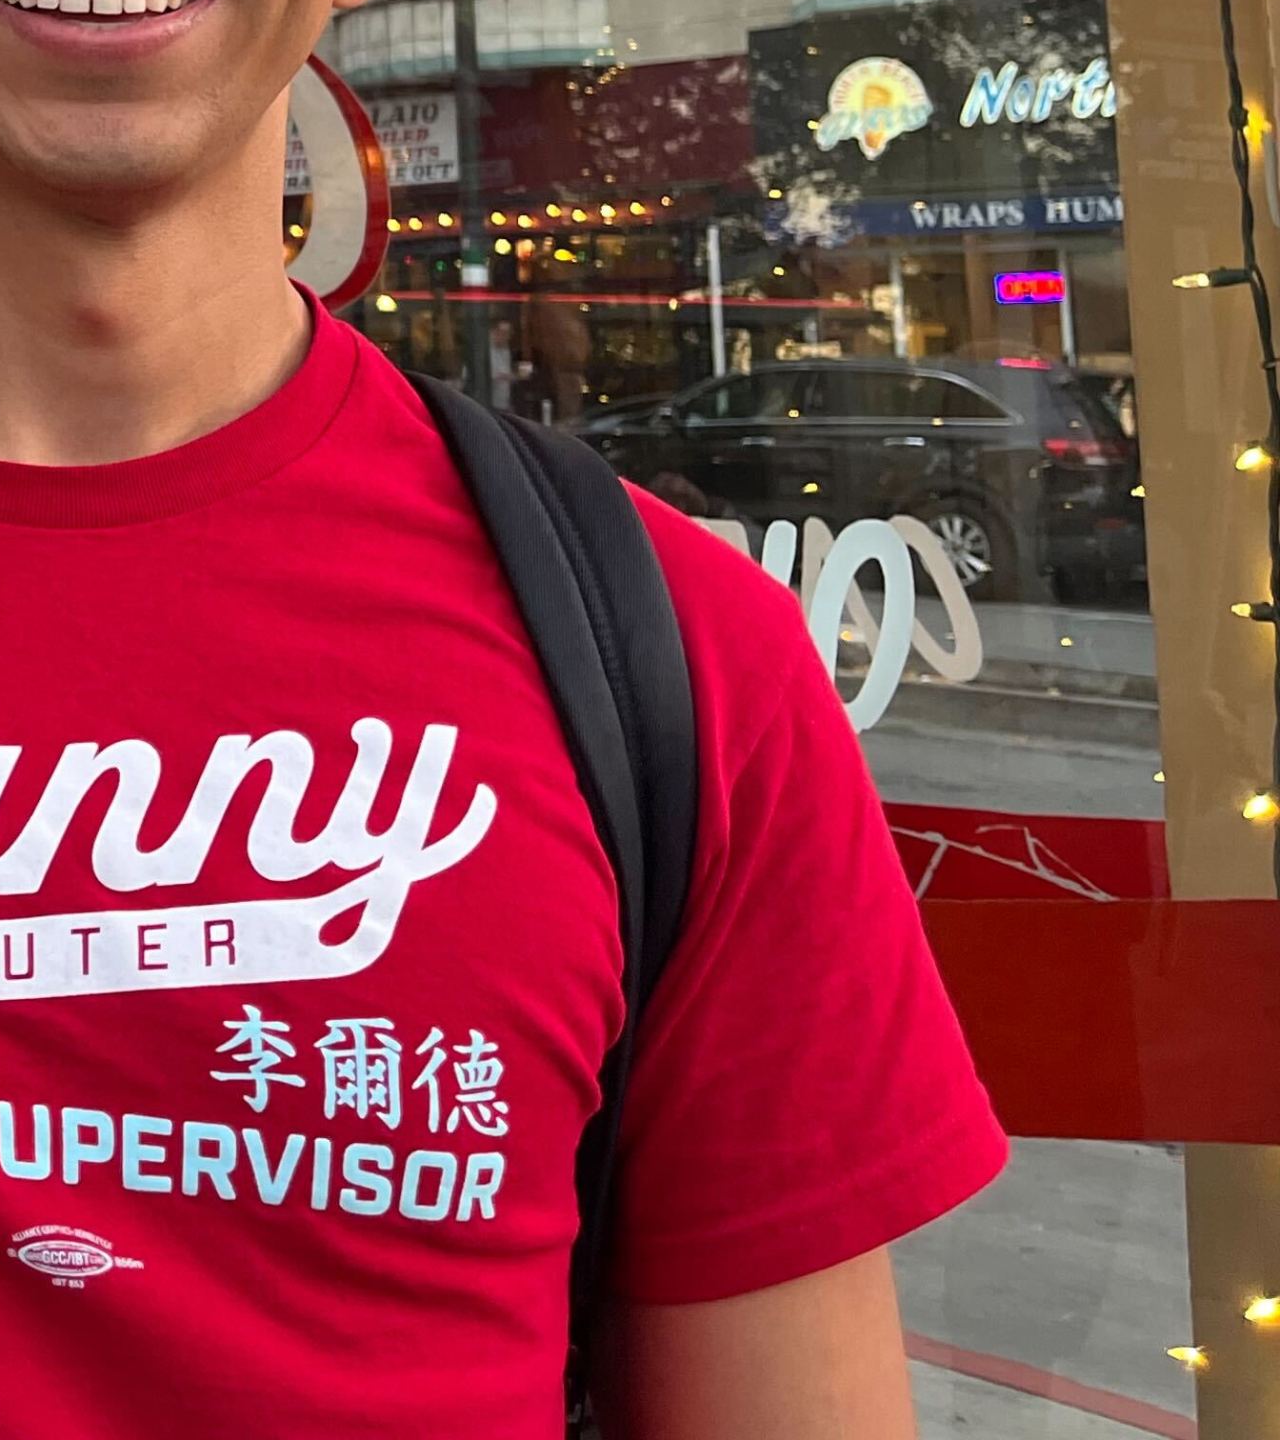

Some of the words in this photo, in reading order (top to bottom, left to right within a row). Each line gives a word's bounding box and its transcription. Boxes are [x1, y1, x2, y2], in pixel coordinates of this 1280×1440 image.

[910, 199, 1025, 230] WRAPS
[209, 1004, 510, 1138] 李爾德
